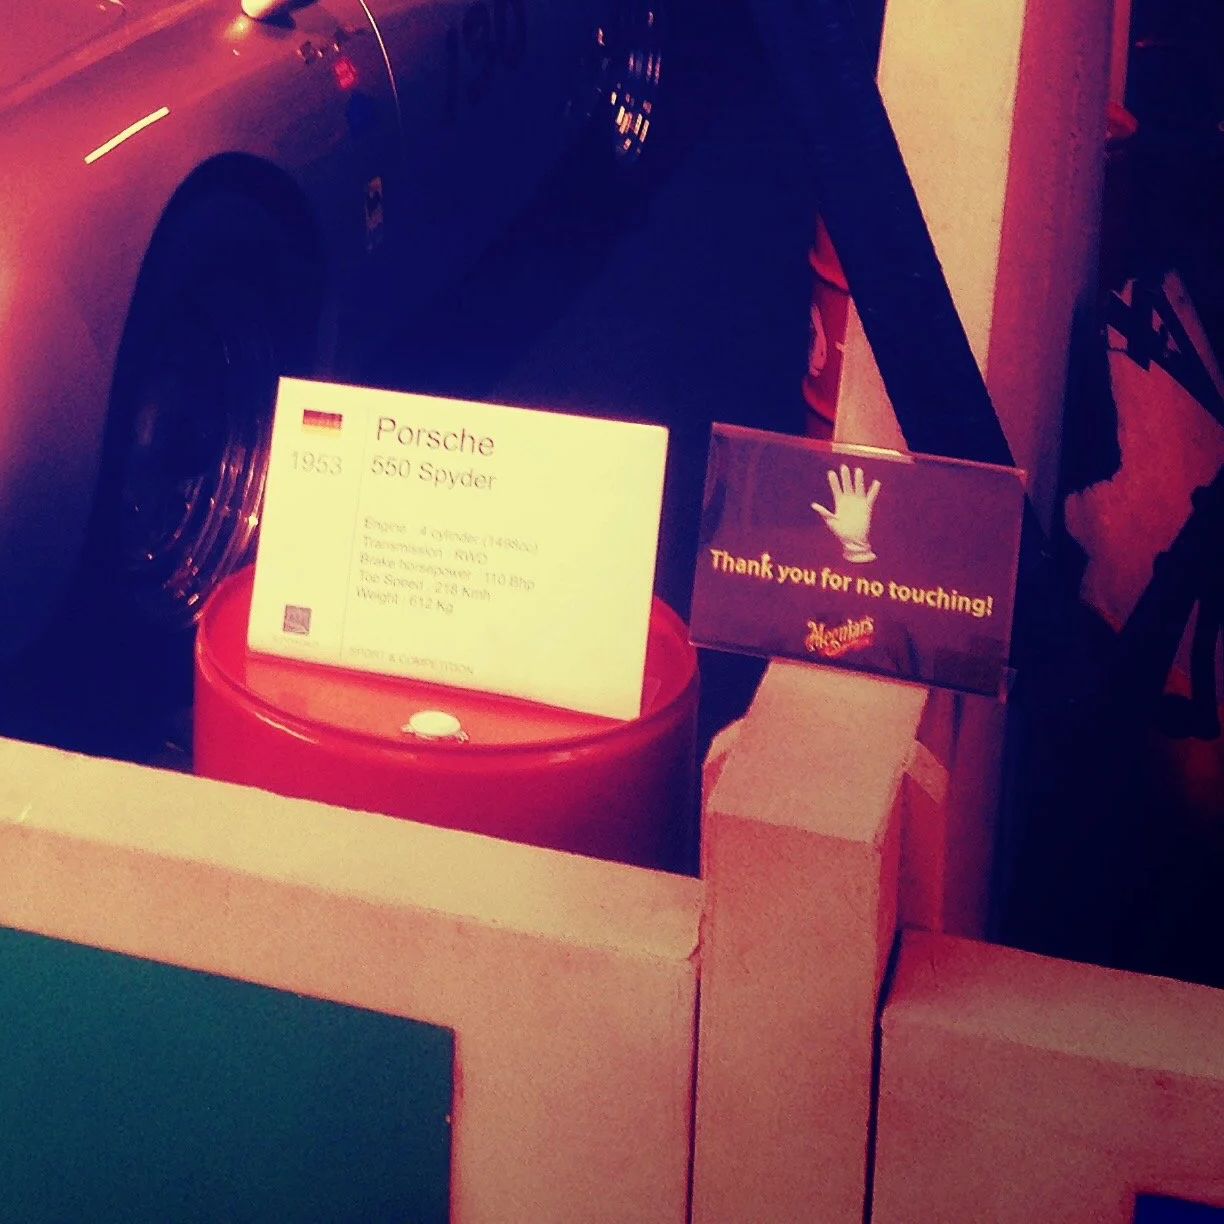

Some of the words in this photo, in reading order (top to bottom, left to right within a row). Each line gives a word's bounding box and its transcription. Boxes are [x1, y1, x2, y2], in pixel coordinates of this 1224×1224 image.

[376, 416, 495, 457] Porsche
[290, 450, 343, 476] 1953
[371, 455, 411, 479] 550
[419, 462, 497, 491] Spyder
[359, 569, 380, 585] Top
[360, 552, 396, 569] Brake
[399, 559, 472, 580] horsepower
[509, 575, 536, 592] Bhp
[710, 548, 773, 579] Thank
[777, 564, 817, 584] you
[821, 567, 853, 592] for
[856, 578, 885, 598] no
[888, 581, 994, 618] touching!
[436, 599, 454, 616] Kg
